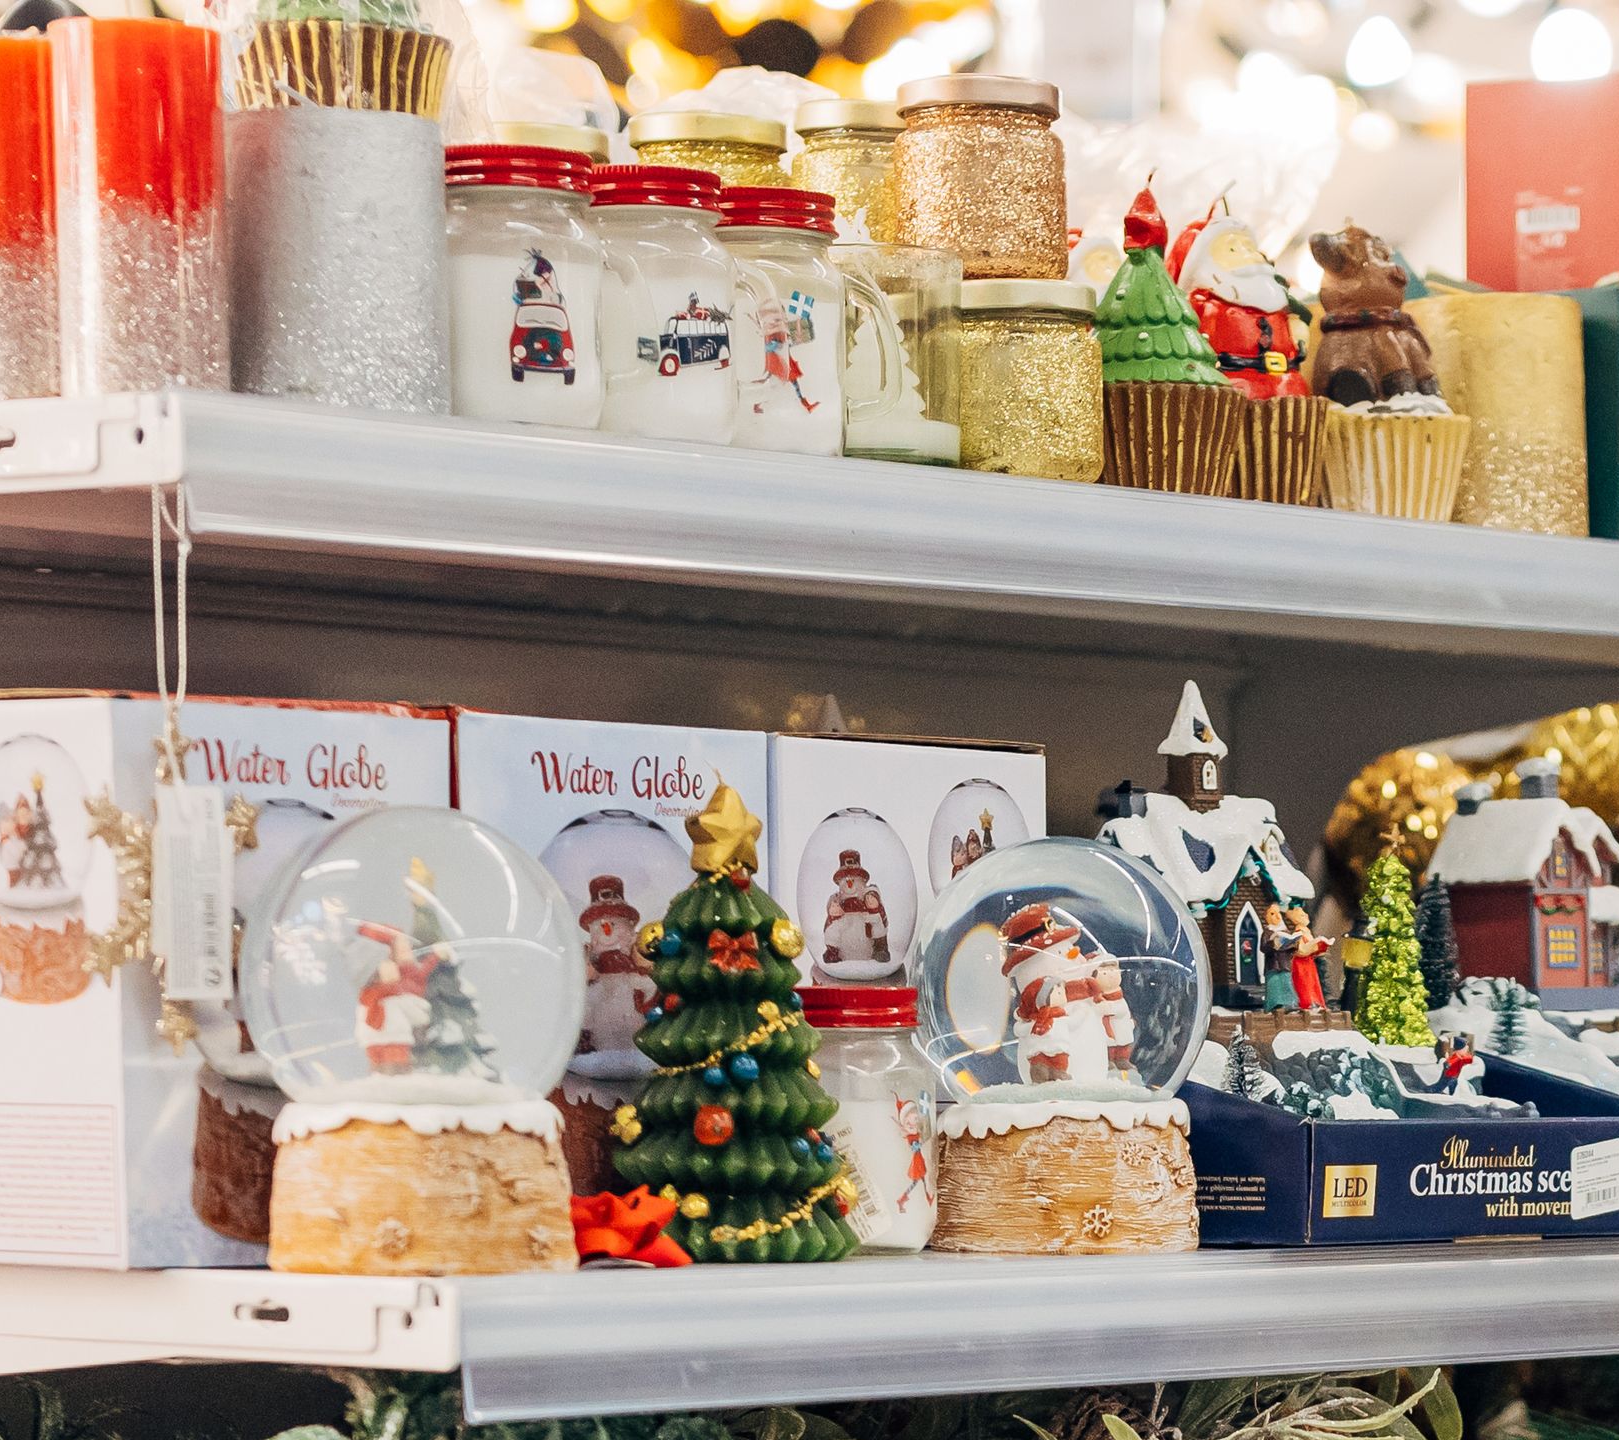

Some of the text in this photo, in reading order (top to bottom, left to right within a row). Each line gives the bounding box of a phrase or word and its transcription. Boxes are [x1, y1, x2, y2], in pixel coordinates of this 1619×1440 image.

[187, 738, 388, 792] Water Globe
[531, 750, 706, 800] Water Globe
[1440, 1134, 1538, 1170] Illuminated
[1333, 1177, 1368, 1198] LED
[1409, 1163, 1533, 1197] Christmas
[1485, 1197, 1519, 1217] with
